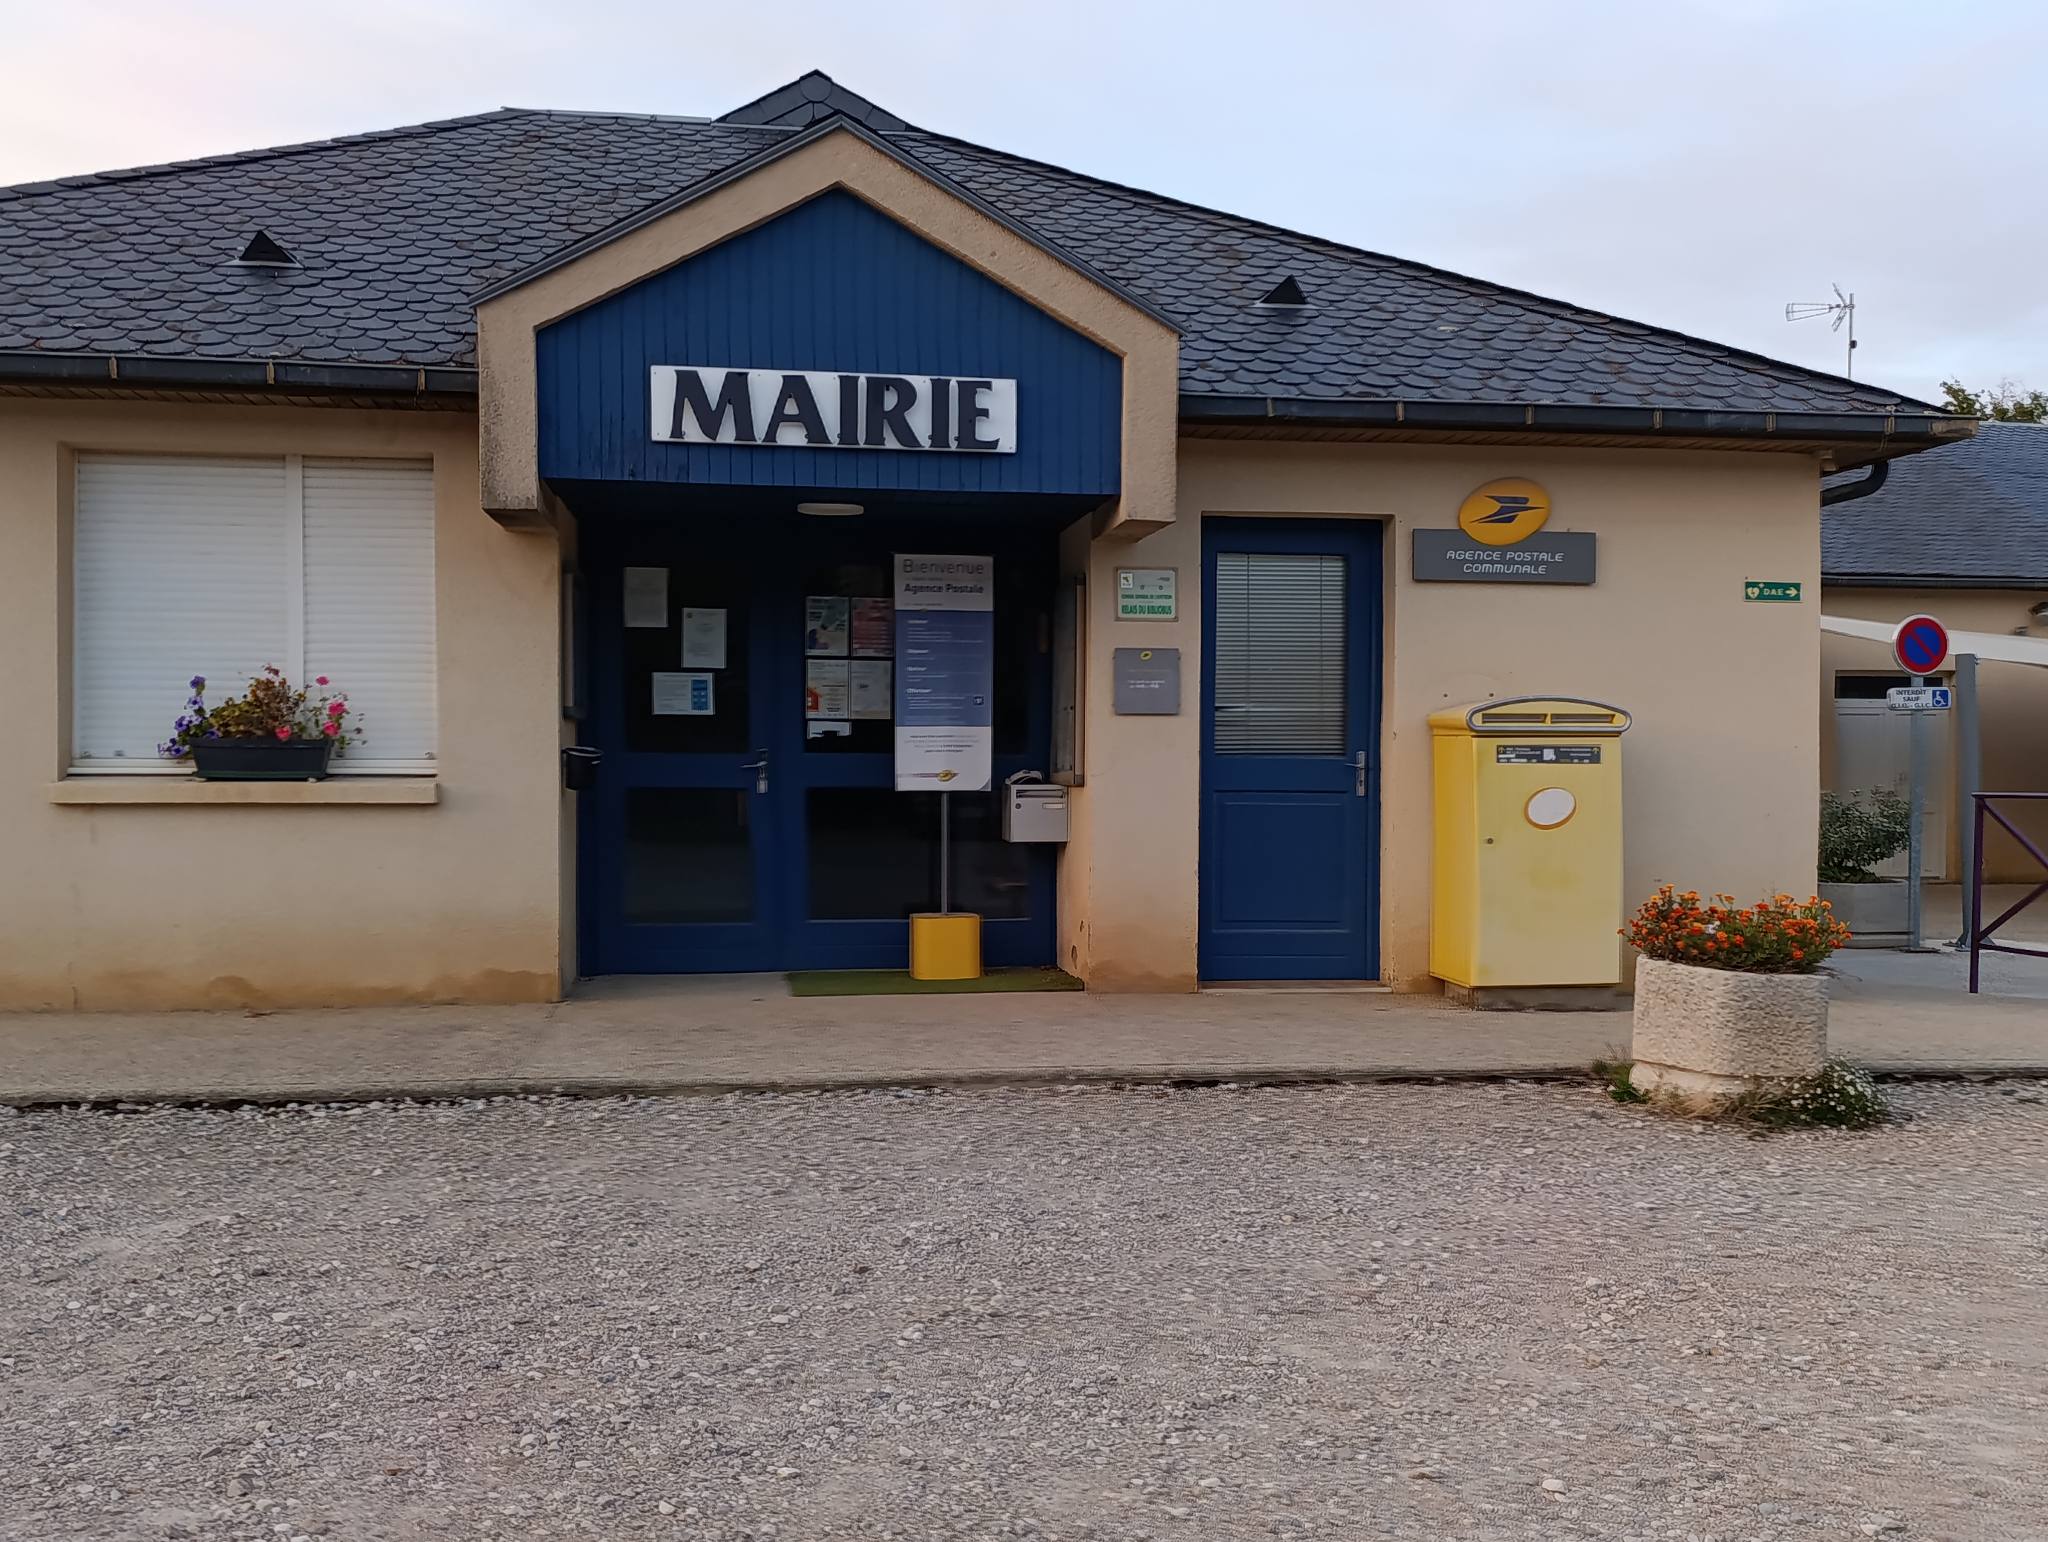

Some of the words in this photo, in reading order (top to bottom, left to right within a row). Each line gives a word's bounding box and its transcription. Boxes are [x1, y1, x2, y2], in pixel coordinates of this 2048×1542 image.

[669, 369, 1000, 450] MAIRIE
[1446, 550, 1502, 561] AGENCE
[1506, 551, 1565, 562] POSTALE
[903, 559, 984, 575] Bienvenue
[1463, 563, 1548, 574] COMMUNALE
[904, 583, 943, 595] Agence
[945, 583, 985, 594] Postale
[1763, 588, 1784, 596] DAE
